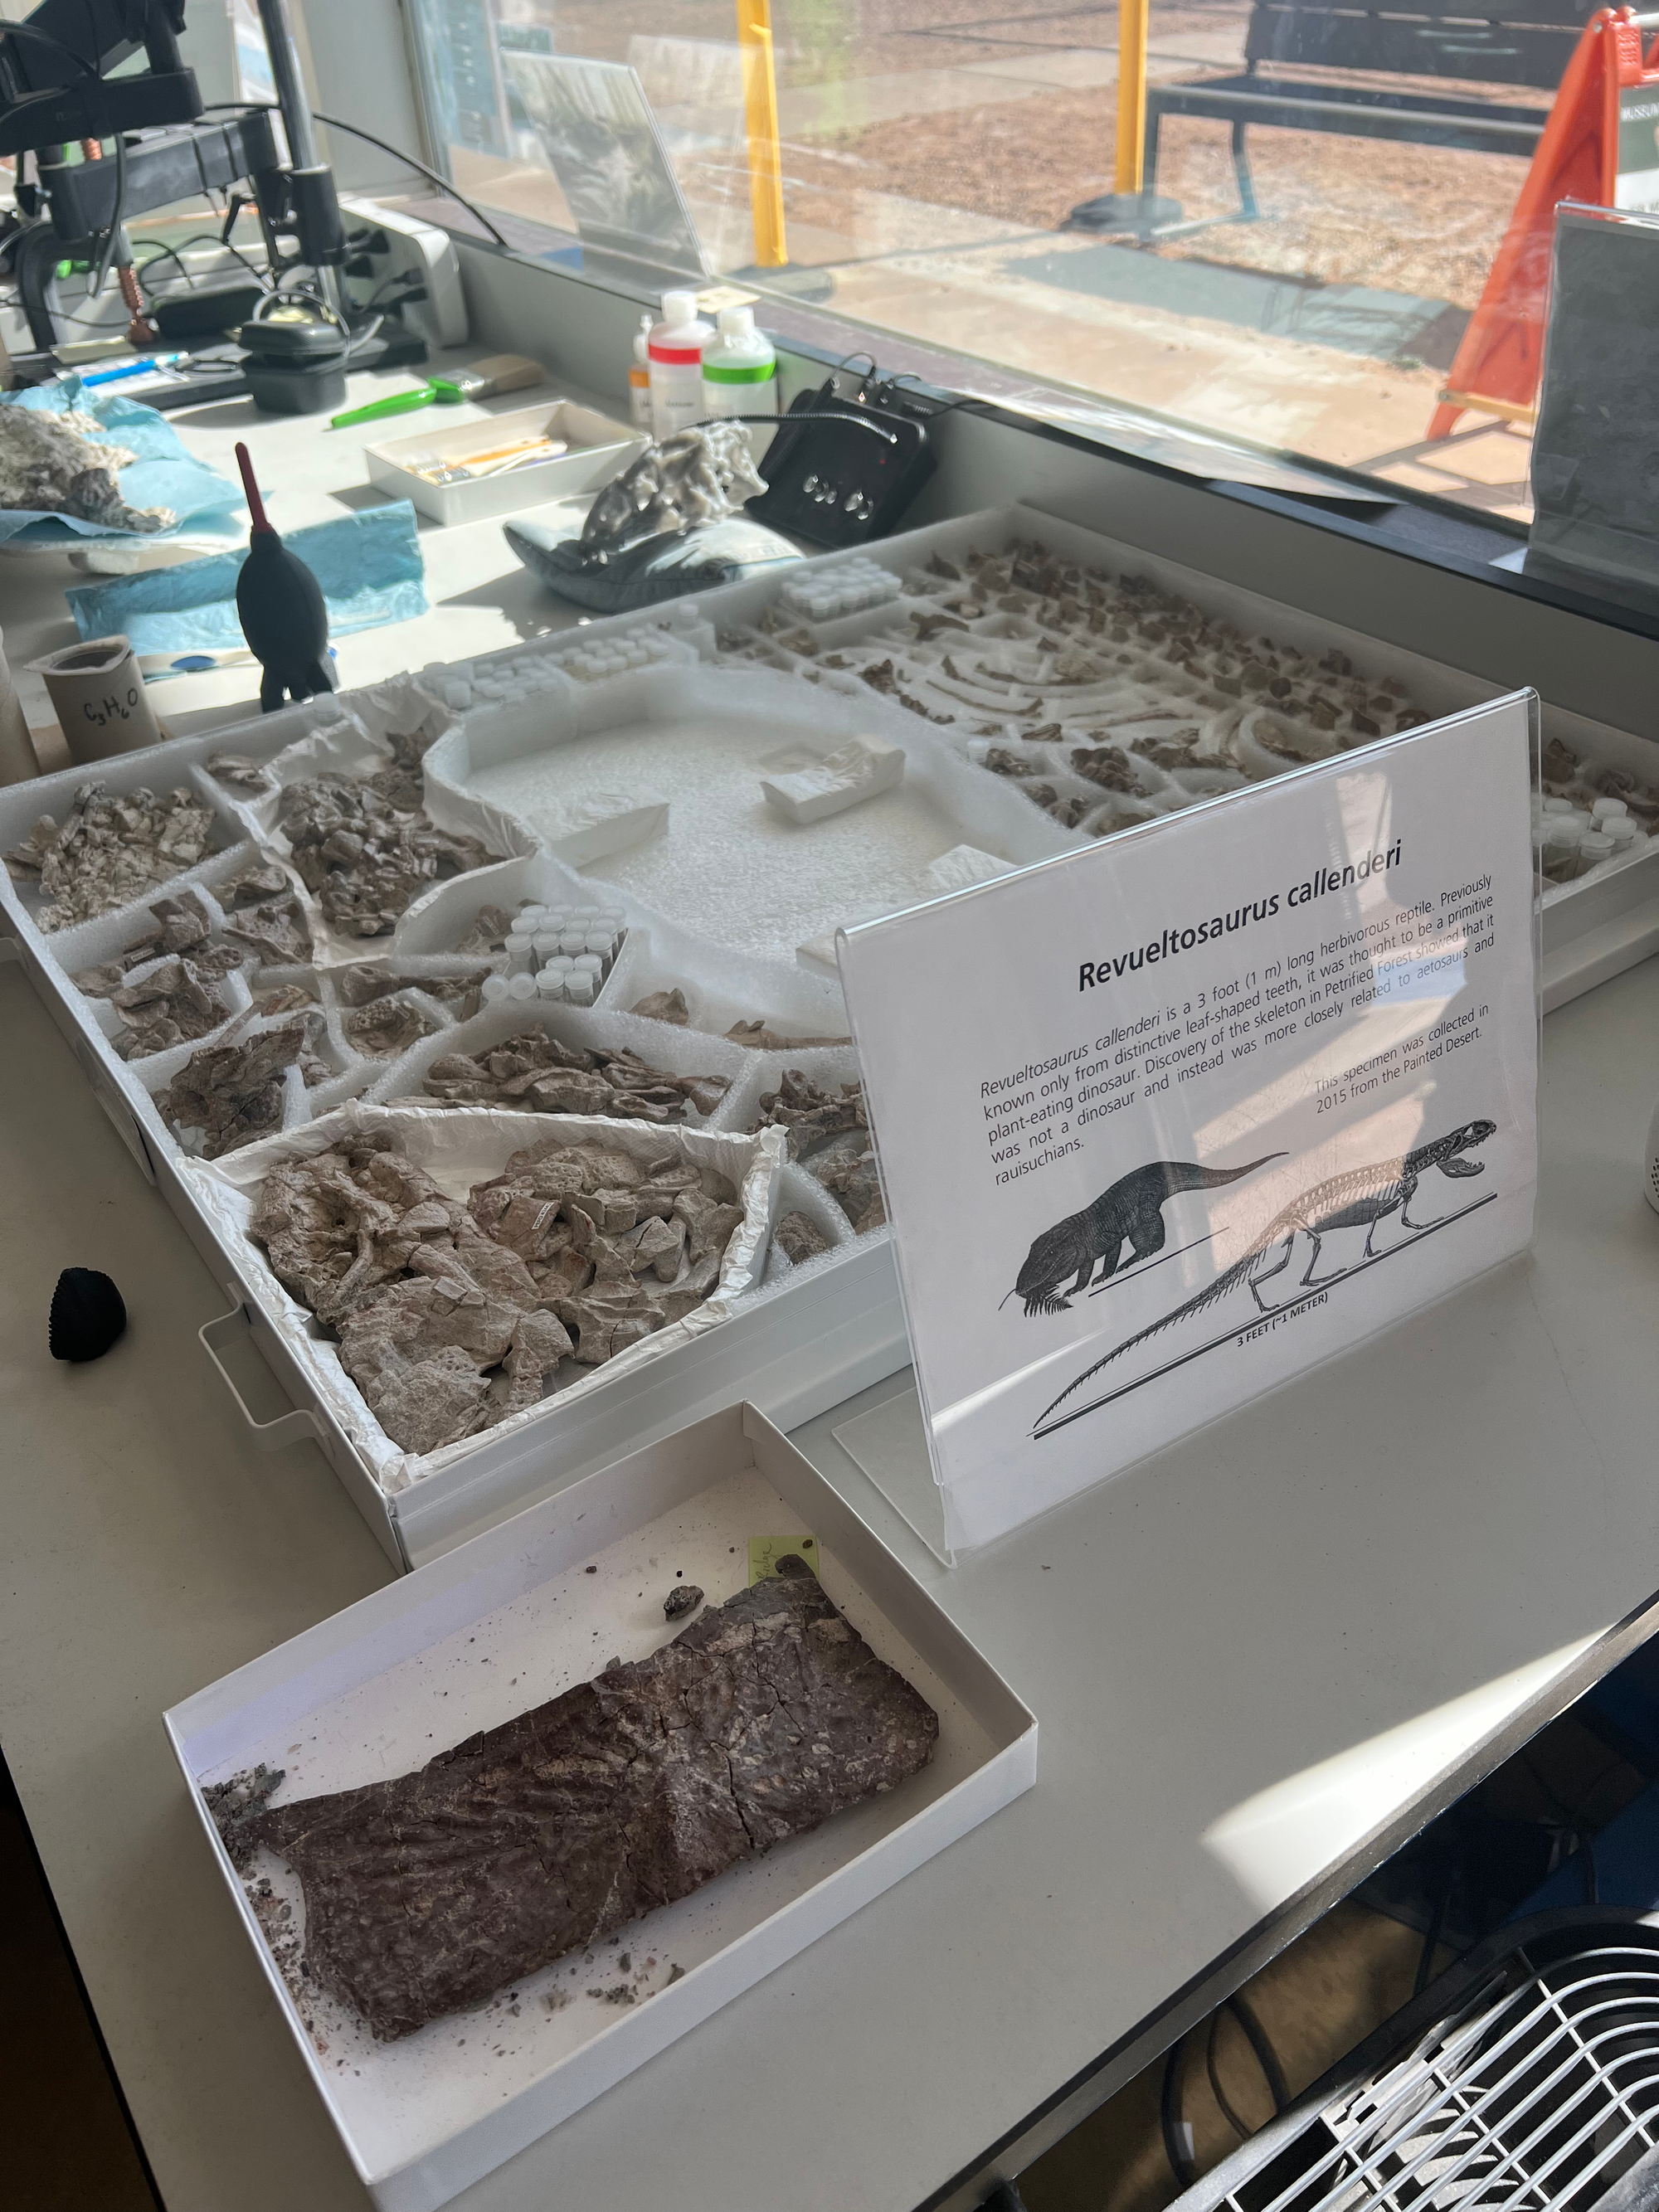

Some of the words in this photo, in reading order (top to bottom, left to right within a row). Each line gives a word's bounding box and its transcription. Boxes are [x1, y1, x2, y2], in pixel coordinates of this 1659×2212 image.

[980, 1043, 1089, 1100] Revueltosaurus
[1095, 1009, 1160, 1052] callenderi
[1165, 1006, 1177, 1022] is
[1182, 1002, 1191, 1015] a
[1197, 992, 1206, 1009] 3
[1211, 980, 1240, 1002] foot
[1245, 970, 1257, 990] (1
[1264, 960, 1282, 980] m)
[1287, 950, 1315, 971] long
[1320, 918, 1390, 957] herbivorous
[1395, 900, 1435, 926] reptile.
[1440, 873, 1492, 907] Previously
[1078, 893, 1280, 993] Revueltosaurus
[1287, 838, 1403, 908] callenderi
[983, 1091, 1035, 1121] known
[1040, 1073, 1070, 1097] only
[1074, 1059, 1109, 1082] from
[1114, 1028, 1181, 1066] distinctive
[1185, 989, 1260, 1036] leaf-shaped
[1264, 976, 1302, 1001] teeth,
[1306, 969, 1316, 984] it
[1319, 959, 1345, 978] was
[1348, 935, 1399, 966] thought
[1399, 931, 1413, 946] to
[1418, 922, 1433, 937] be
[1437, 917, 1444, 930] a
[1447, 896, 1493, 929] primitive
[988, 1096, 1074, 1147] plant-eating
[1078, 1068, 1141, 1104] dinosaur.
[1145, 1038, 1207, 1075] Discovery
[1211, 1026, 1225, 1046] of
[1228, 1020, 1251, 1038] the
[1253, 997, 1306, 1028] skeleton
[1309, 989, 1321, 1004] in
[1325, 964, 1374, 999] Petrified
[1377, 950, 1413, 975] Forest
[1416, 926, 1461, 960] showed
[1460, 918, 1485, 939] that
[1486, 913, 1495, 928] it
[990, 1142, 1021, 1164] was
[1029, 1126, 1053, 1149] not
[1060, 1121, 1070, 1135] a
[1077, 1091, 1136, 1126] dinosaur
[1144, 1072, 1170, 1098] and
[1176, 1049, 1224, 1083] instead
[1231, 1039, 1258, 1059] was
[1264, 1023, 1297, 1046] more
[1304, 1000, 1344, 1028] closely
[1350, 977, 1391, 1009] related
[1397, 974, 1411, 988] to
[1417, 946, 1469, 980] aetosaurs
[1474, 931, 1495, 954] and
[1314, 1074, 1339, 1094] This
[1343, 1048, 1398, 1082] specimen
[1402, 1035, 1424, 1054] was
[1428, 1007, 1475, 1042] collected
[1479, 1004, 1489, 1018] in
[1316, 1088, 1347, 1115] 2015
[1350, 1077, 1379, 1098] from
[1381, 1067, 1401, 1084] the
[1404, 1042, 1443, 1074] Painted
[1445, 1026, 1482, 1053] Desert.
[995, 1138, 1085, 1186] rauisuchians.
[1237, 1336, 1243, 1348] 3
[1246, 1322, 1270, 1343] FEET
[1272, 1313, 1287, 1330] (~1
[1290, 1291, 1329, 1320] METER)
